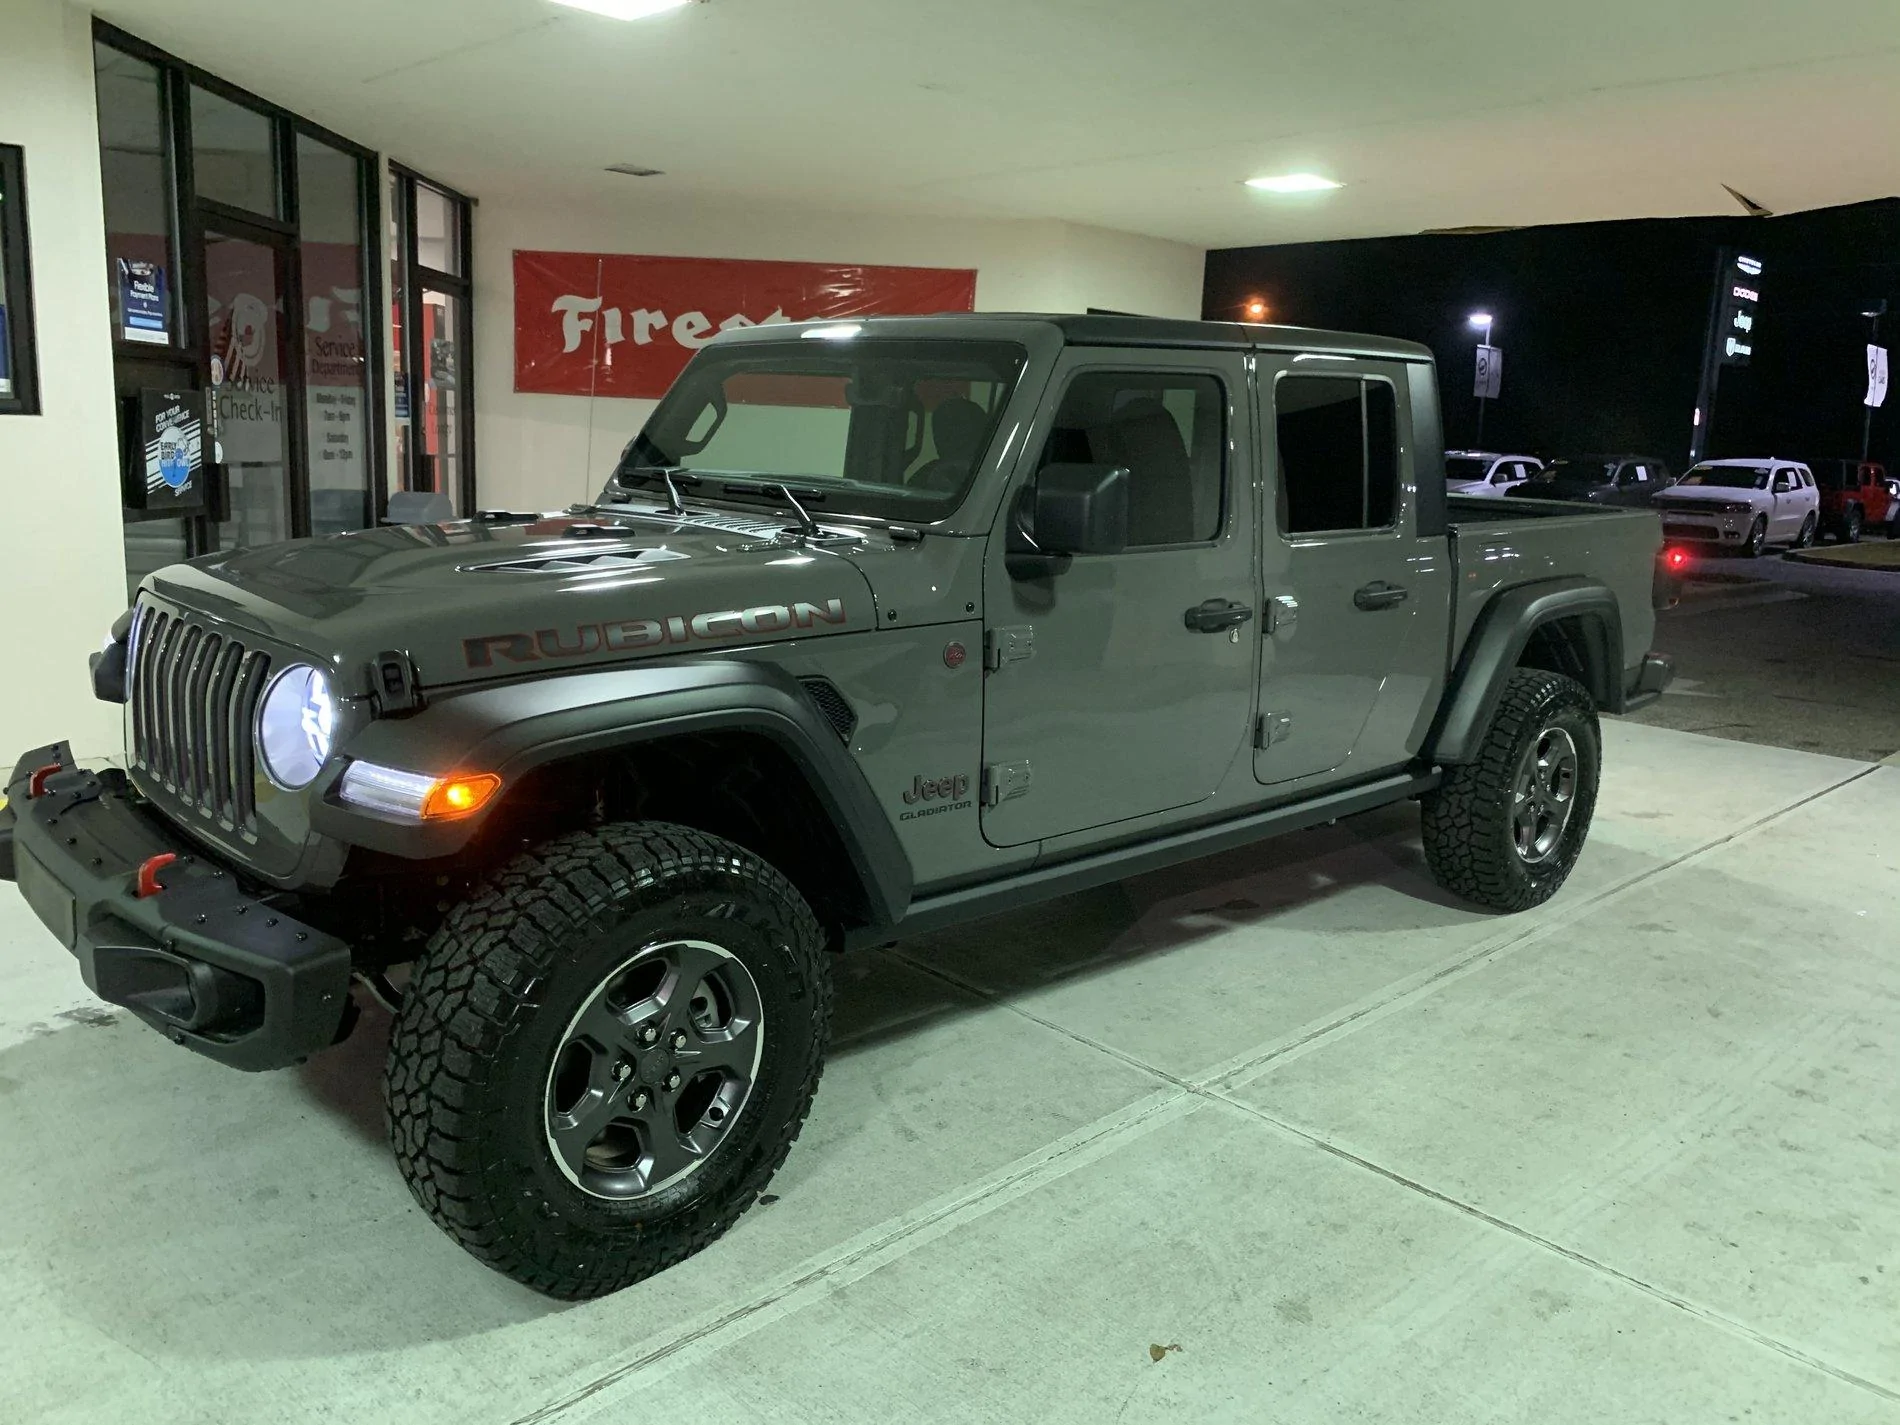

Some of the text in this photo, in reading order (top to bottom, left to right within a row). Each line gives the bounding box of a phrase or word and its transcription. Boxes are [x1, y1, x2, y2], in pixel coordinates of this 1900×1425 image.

[315, 335, 356, 358] Service
[312, 358, 360, 379] Departmen
[155, 405, 180, 425] FOR YOUR
[160, 442, 177, 451] EARLY
[161, 451, 174, 460] BIRD
[462, 598, 847, 669] RUBICON
[903, 773, 969, 805] Jeep
[900, 800, 971, 821] GLADIATOR
